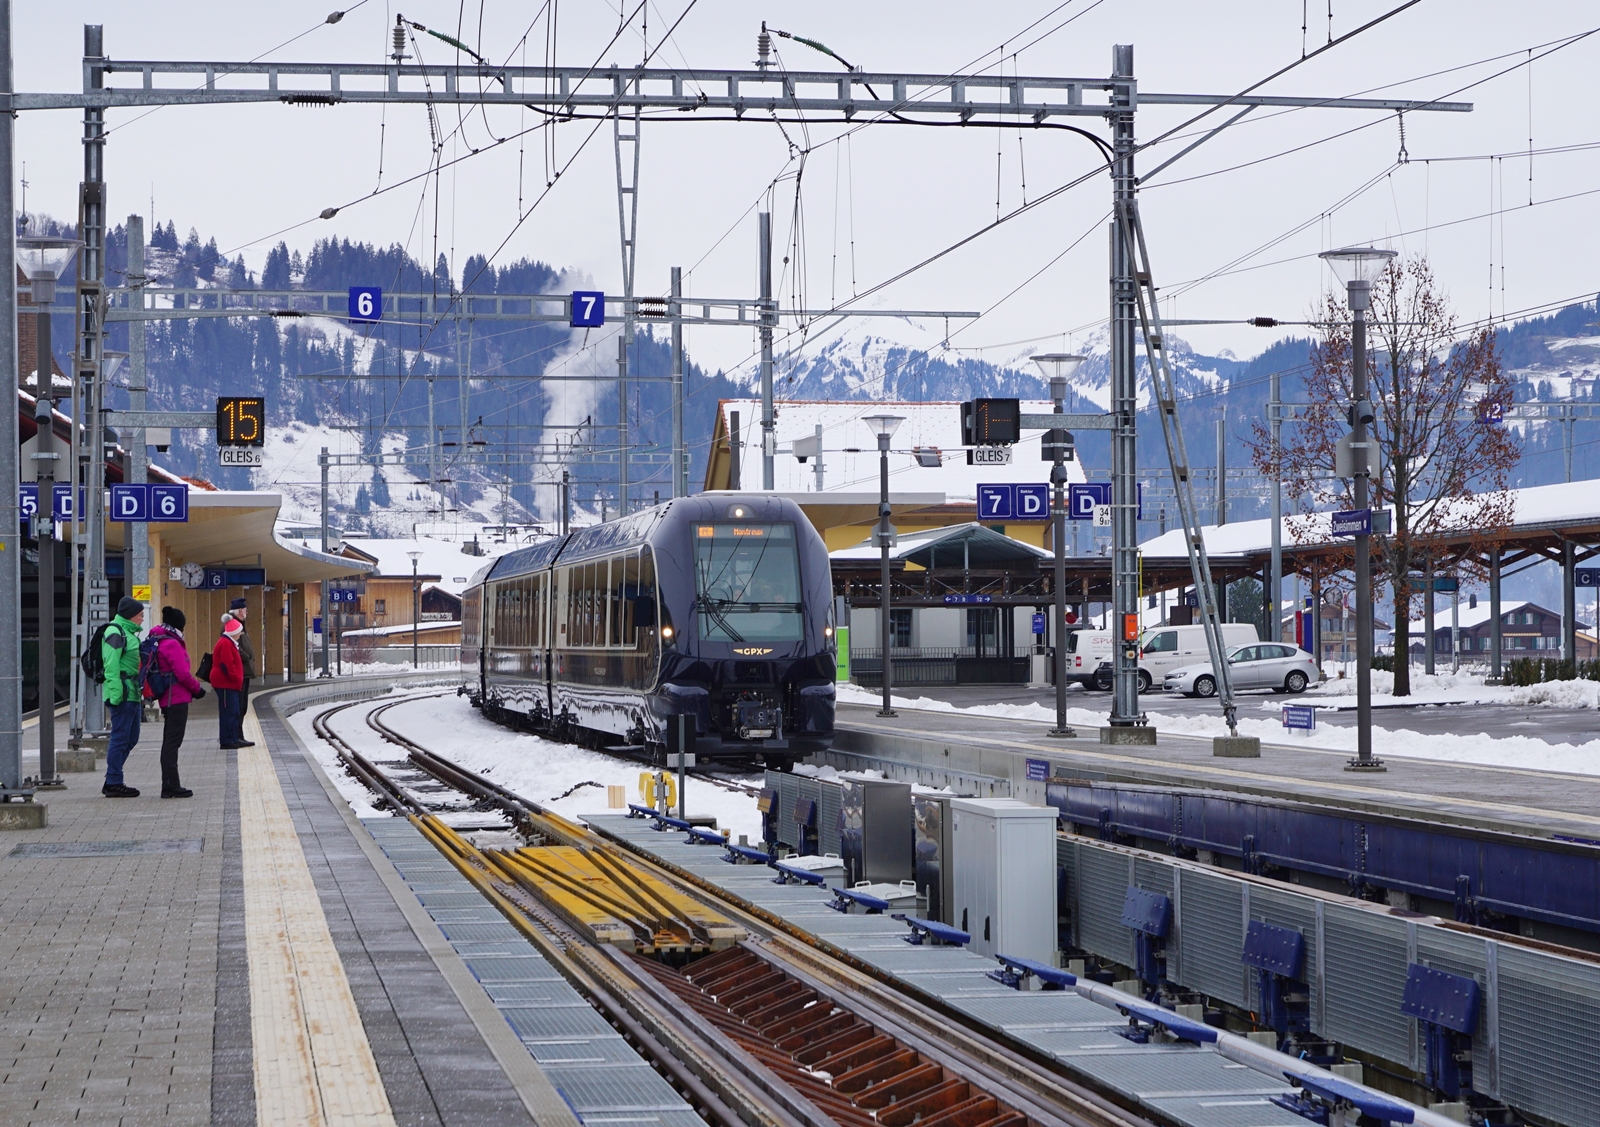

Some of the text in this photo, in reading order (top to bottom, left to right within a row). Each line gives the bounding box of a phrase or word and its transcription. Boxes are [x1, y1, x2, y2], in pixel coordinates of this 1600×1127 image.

[358, 292, 373, 316] 6
[581, 296, 596, 320] 7
[223, 401, 258, 440] 15
[223, 450, 261, 463] GLEIS 6
[975, 450, 1010, 462] GLEIS 7
[22, 496, 37, 515] 5
[122, 496, 138, 515] D
[161, 496, 176, 515] 6
[989, 495, 1002, 513] 7
[1024, 495, 1041, 513] D
[1080, 495, 1096, 513] D
[1099, 507, 1109, 517] 34
[733, 528, 763, 536] Montreux
[1333, 519, 1362, 533] Zweisimmen
[212, 575, 221, 586] 6
[1581, 573, 1590, 584] C
[333, 592, 353, 600] B 6
[743, 648, 763, 656] GPX
